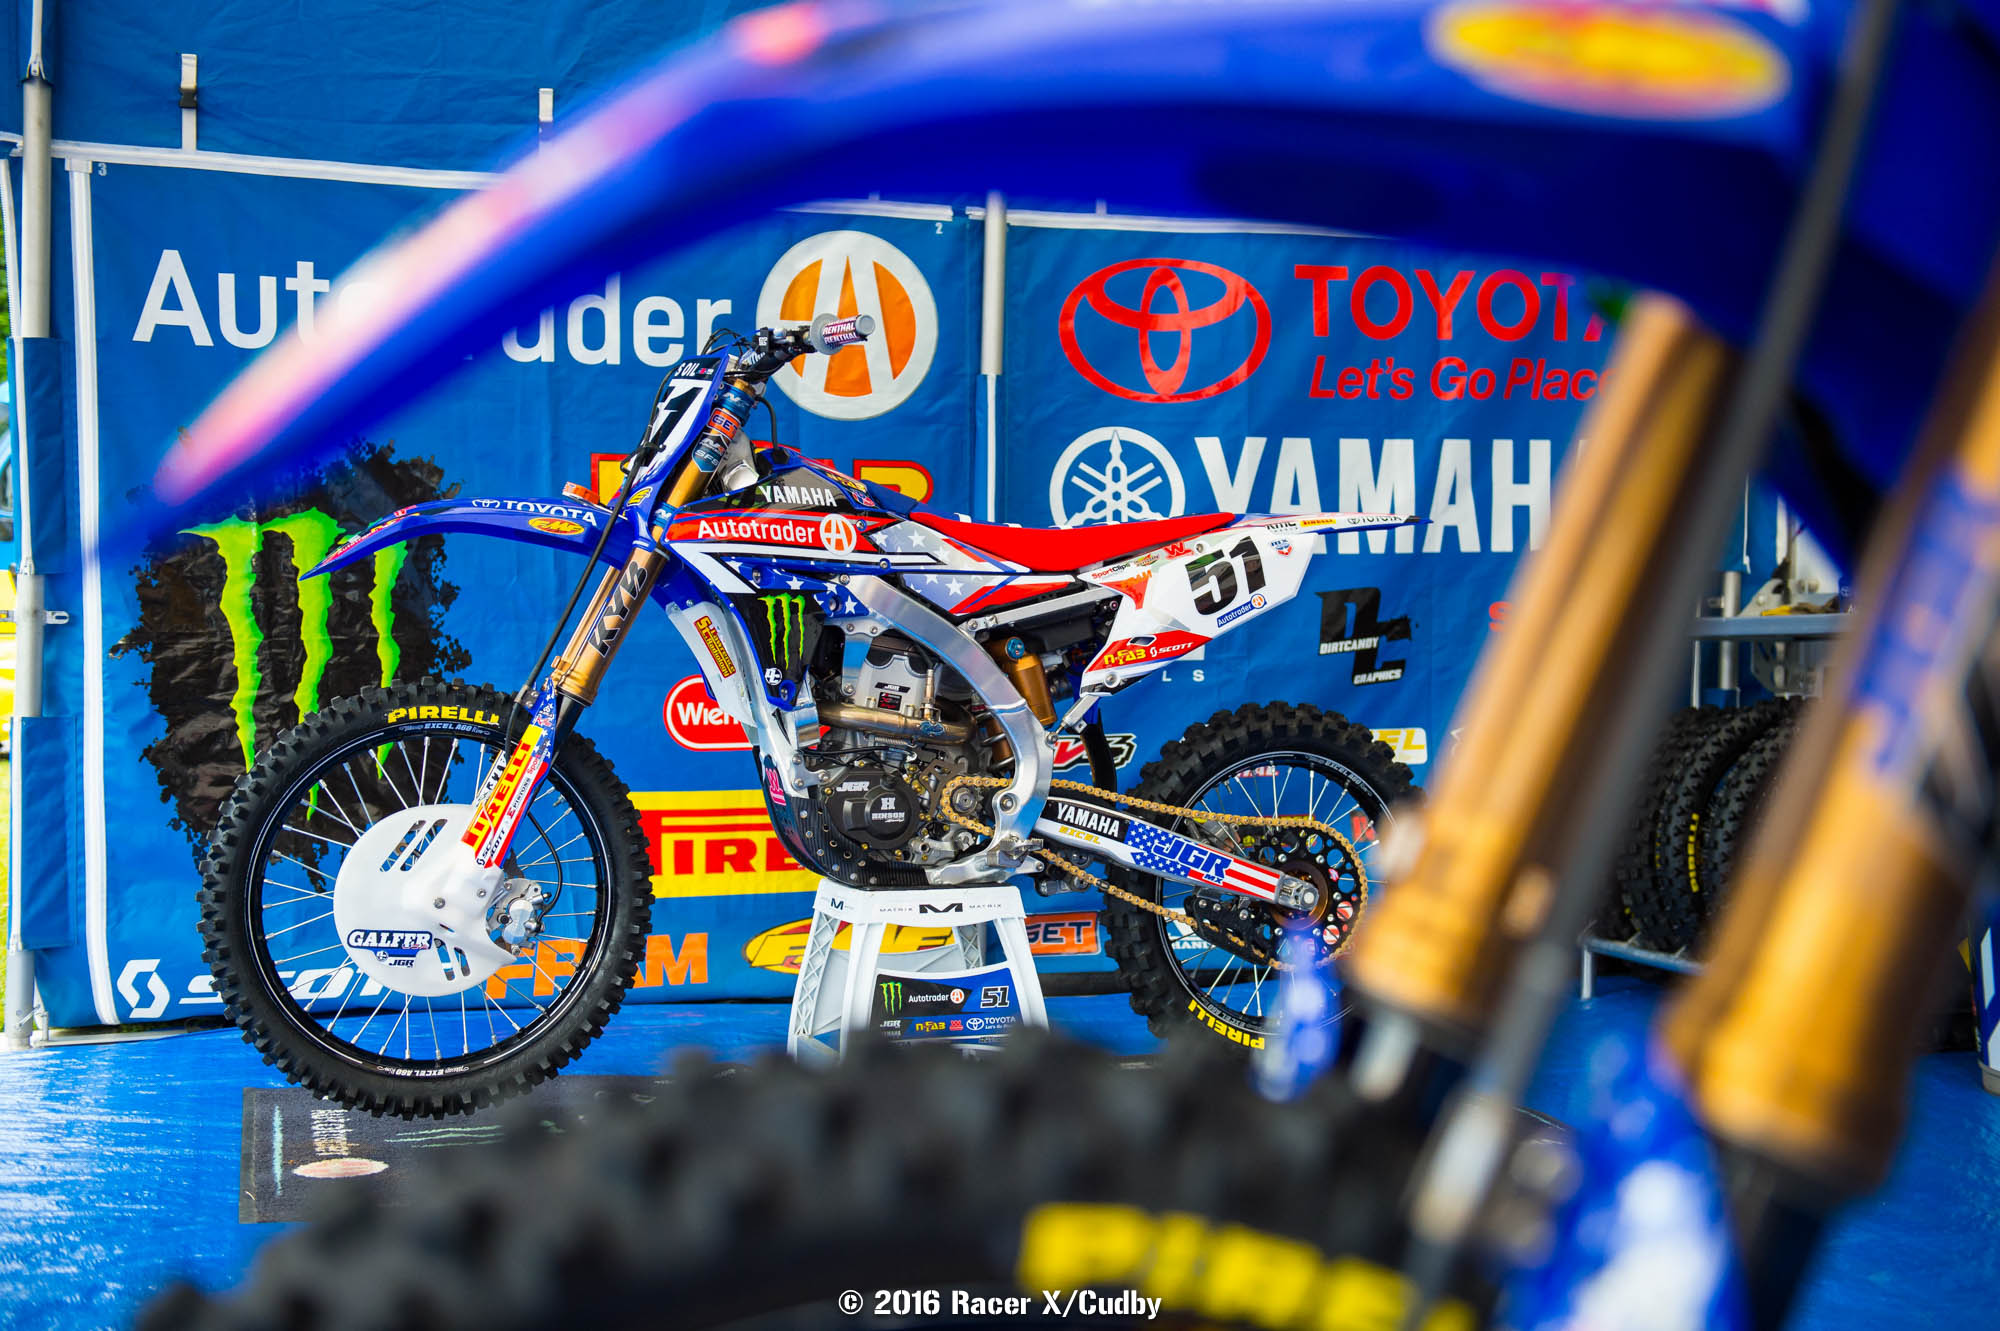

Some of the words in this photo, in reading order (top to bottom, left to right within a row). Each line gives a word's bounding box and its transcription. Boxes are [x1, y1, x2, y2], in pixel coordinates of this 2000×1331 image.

[98, 163, 107, 176] 3
[935, 222, 943, 234] 2
[133, 249, 732, 367] Autader
[1309, 355, 1415, 399] Let's
[1431, 356, 1496, 401] Go
[1504, 357, 1614, 401] Plac
[759, 485, 838, 507] YAMAHA
[1194, 437, 1592, 553] YAMAH
[504, 500, 597, 526] TOYOTA
[698, 520, 815, 544] Autotrader
[1186, 536, 1266, 615] 51
[1217, 604, 1251, 627] Autotrader
[1159, 642, 1194, 654] SCOTT
[1319, 636, 1379, 654] DIRTCANDY
[1353, 669, 1402, 685] GRAPHICS
[388, 705, 499, 724] PIRELLI
[836, 781, 869, 792] JGR
[1057, 803, 1120, 837] YAMAHA
[1059, 825, 1100, 844] EXCEL
[1153, 839, 1234, 879] JGR
[1204, 873, 1223, 885] MX
[349, 931, 431, 948] GALFER
[908, 993, 950, 1003] Autotrader
[980, 986, 1010, 1008] 51
[1188, 999, 1265, 1050] PIRELLI
